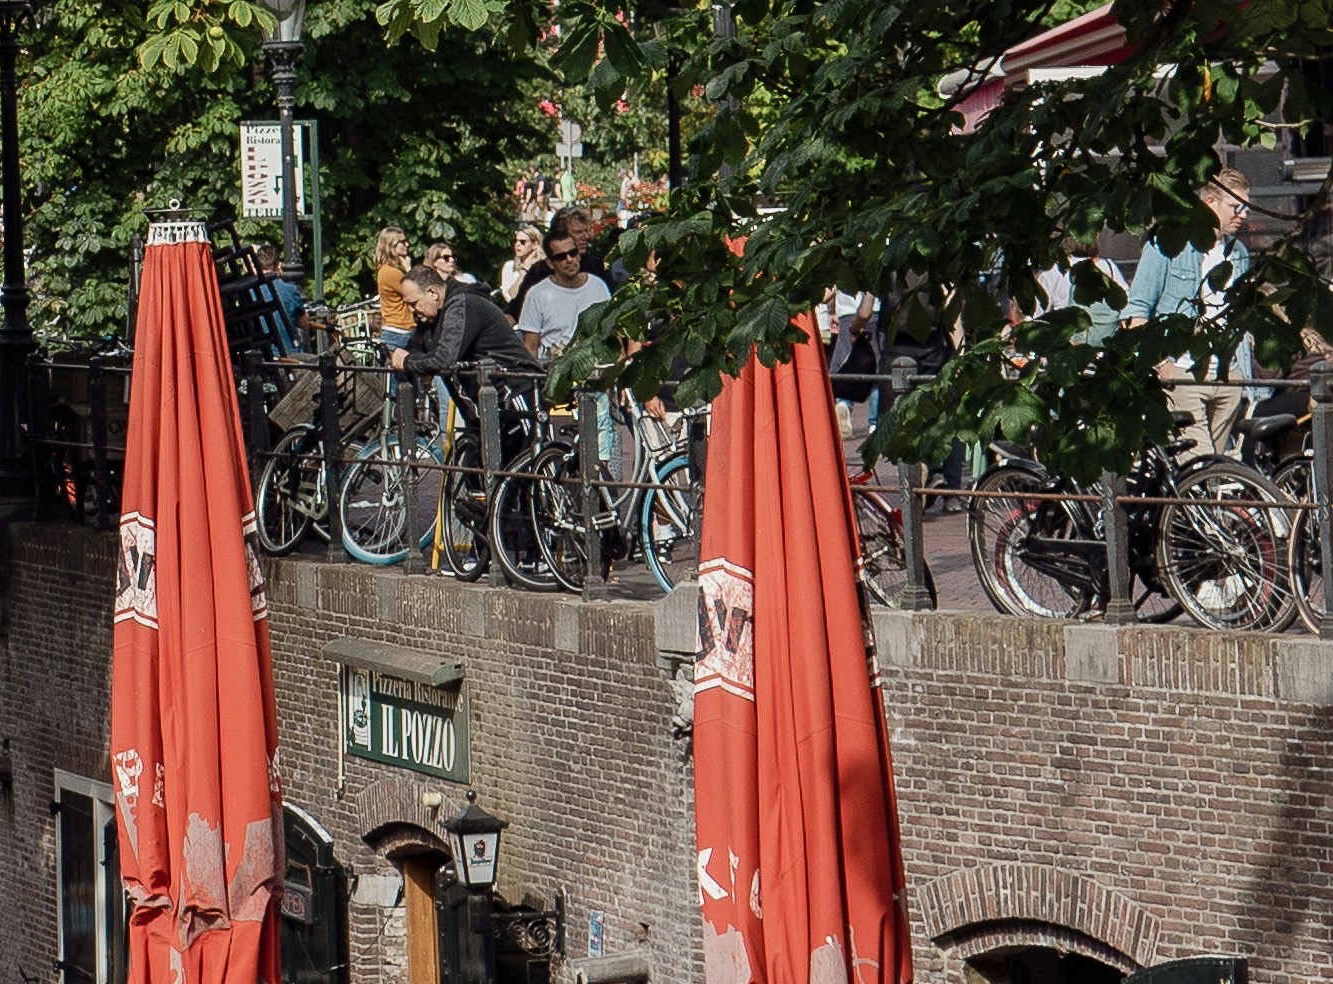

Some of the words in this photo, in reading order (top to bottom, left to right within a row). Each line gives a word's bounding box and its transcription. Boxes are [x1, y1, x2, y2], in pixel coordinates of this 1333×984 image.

[371, 670, 412, 701] Pizzeria
[413, 679, 464, 713] Ristorante
[381, 703, 399, 758] IL
[401, 708, 456, 772] POZZO
